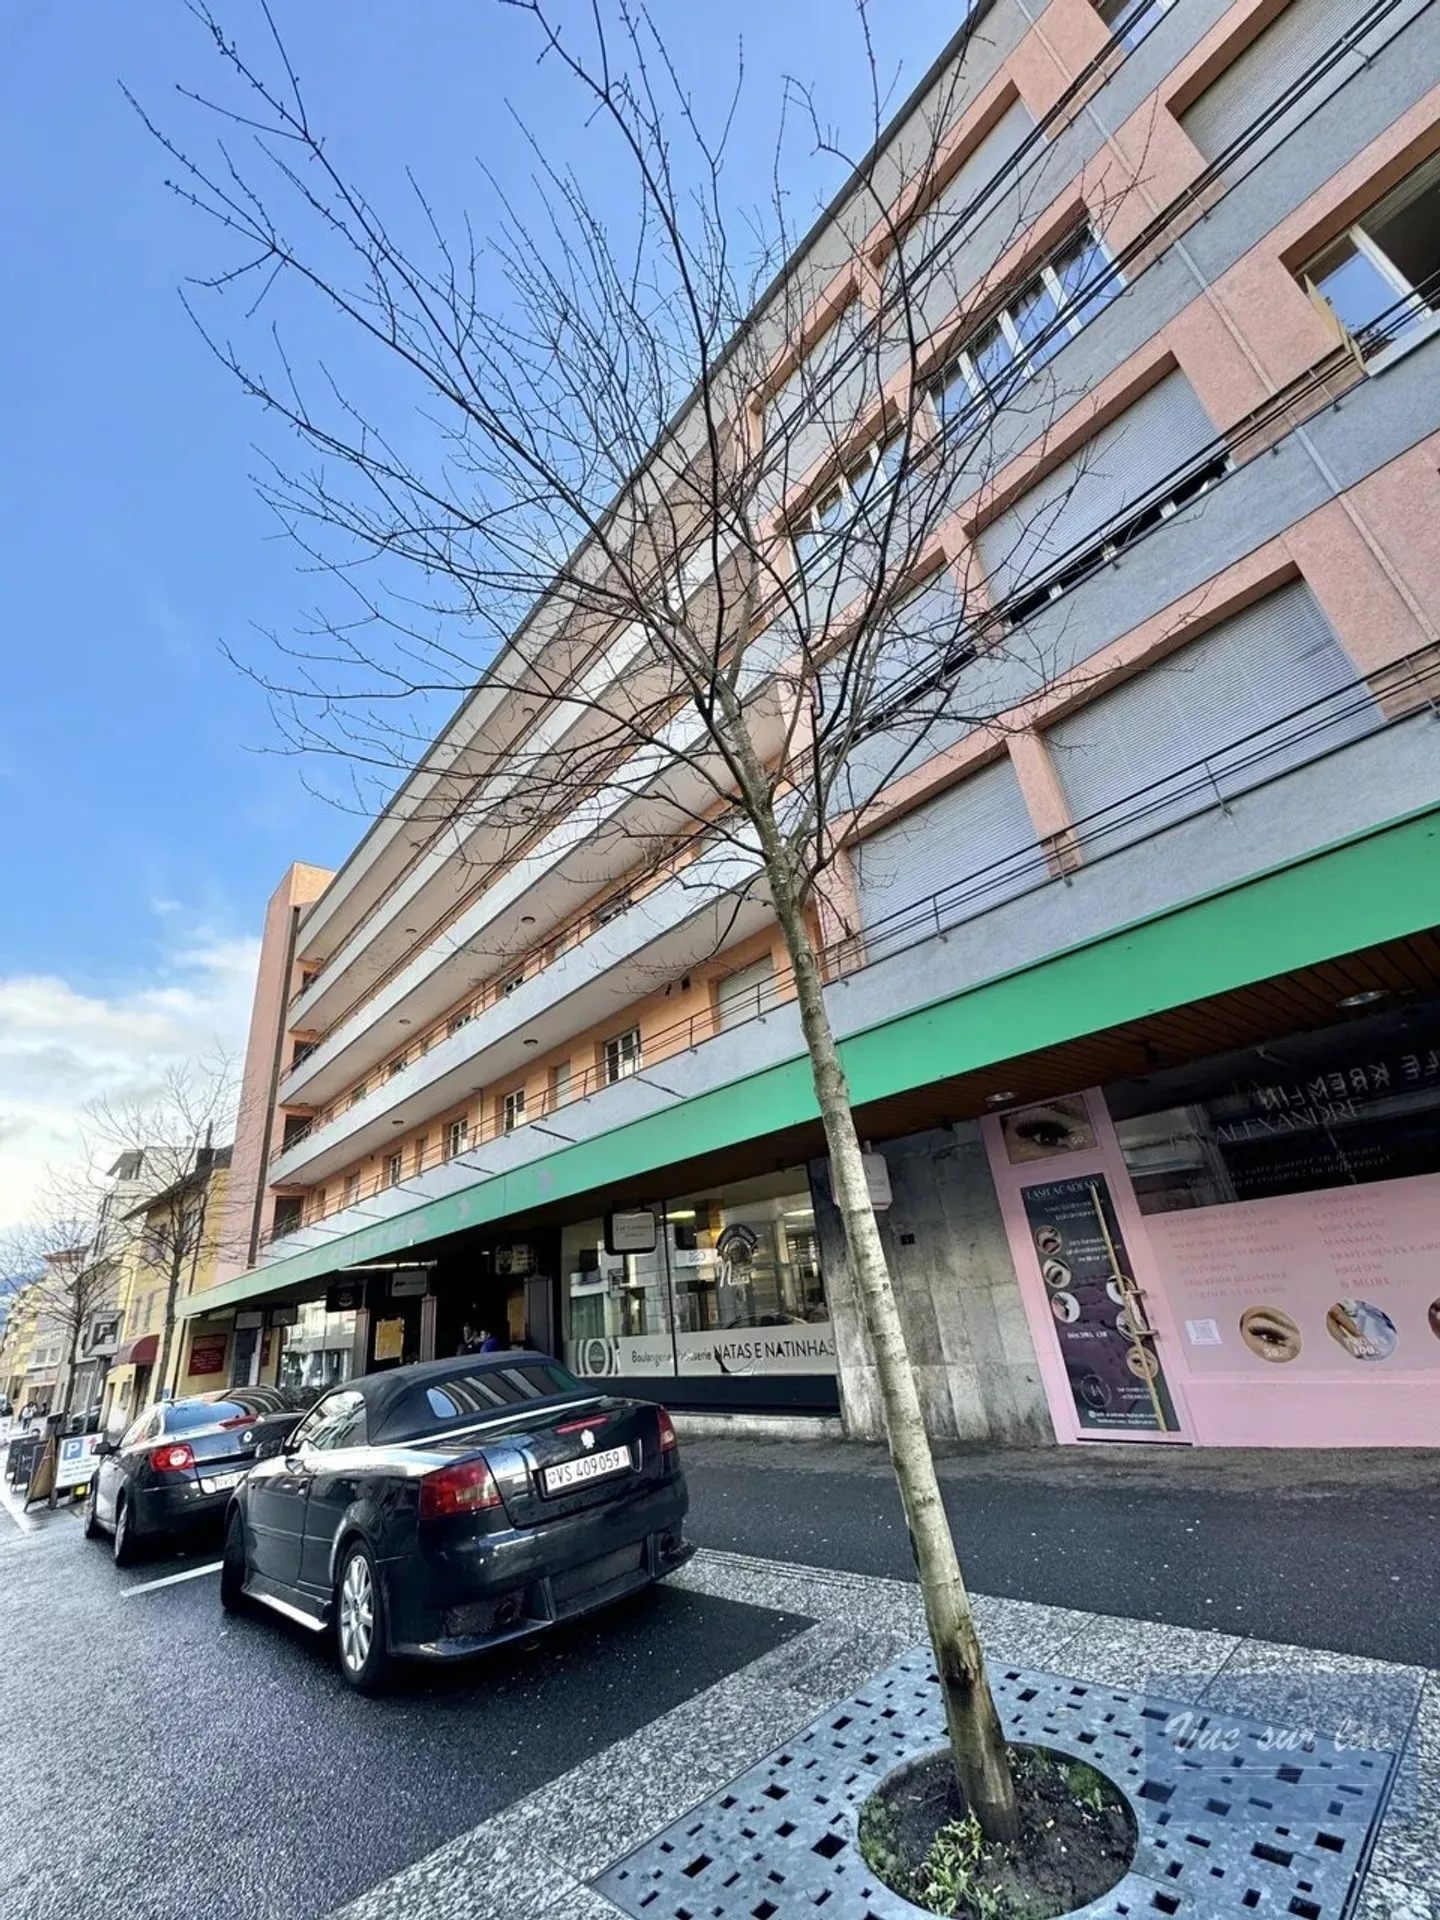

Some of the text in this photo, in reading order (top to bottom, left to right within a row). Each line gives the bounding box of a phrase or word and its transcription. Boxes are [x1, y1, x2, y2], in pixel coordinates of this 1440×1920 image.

[1215, 1097, 1363, 1143] ALEXANDRE
[713, 1343, 752, 1361] NATAS
[754, 1343, 763, 1359] E
[763, 1339, 836, 1358] NATINHAS
[556, 1465, 573, 1484] VS
